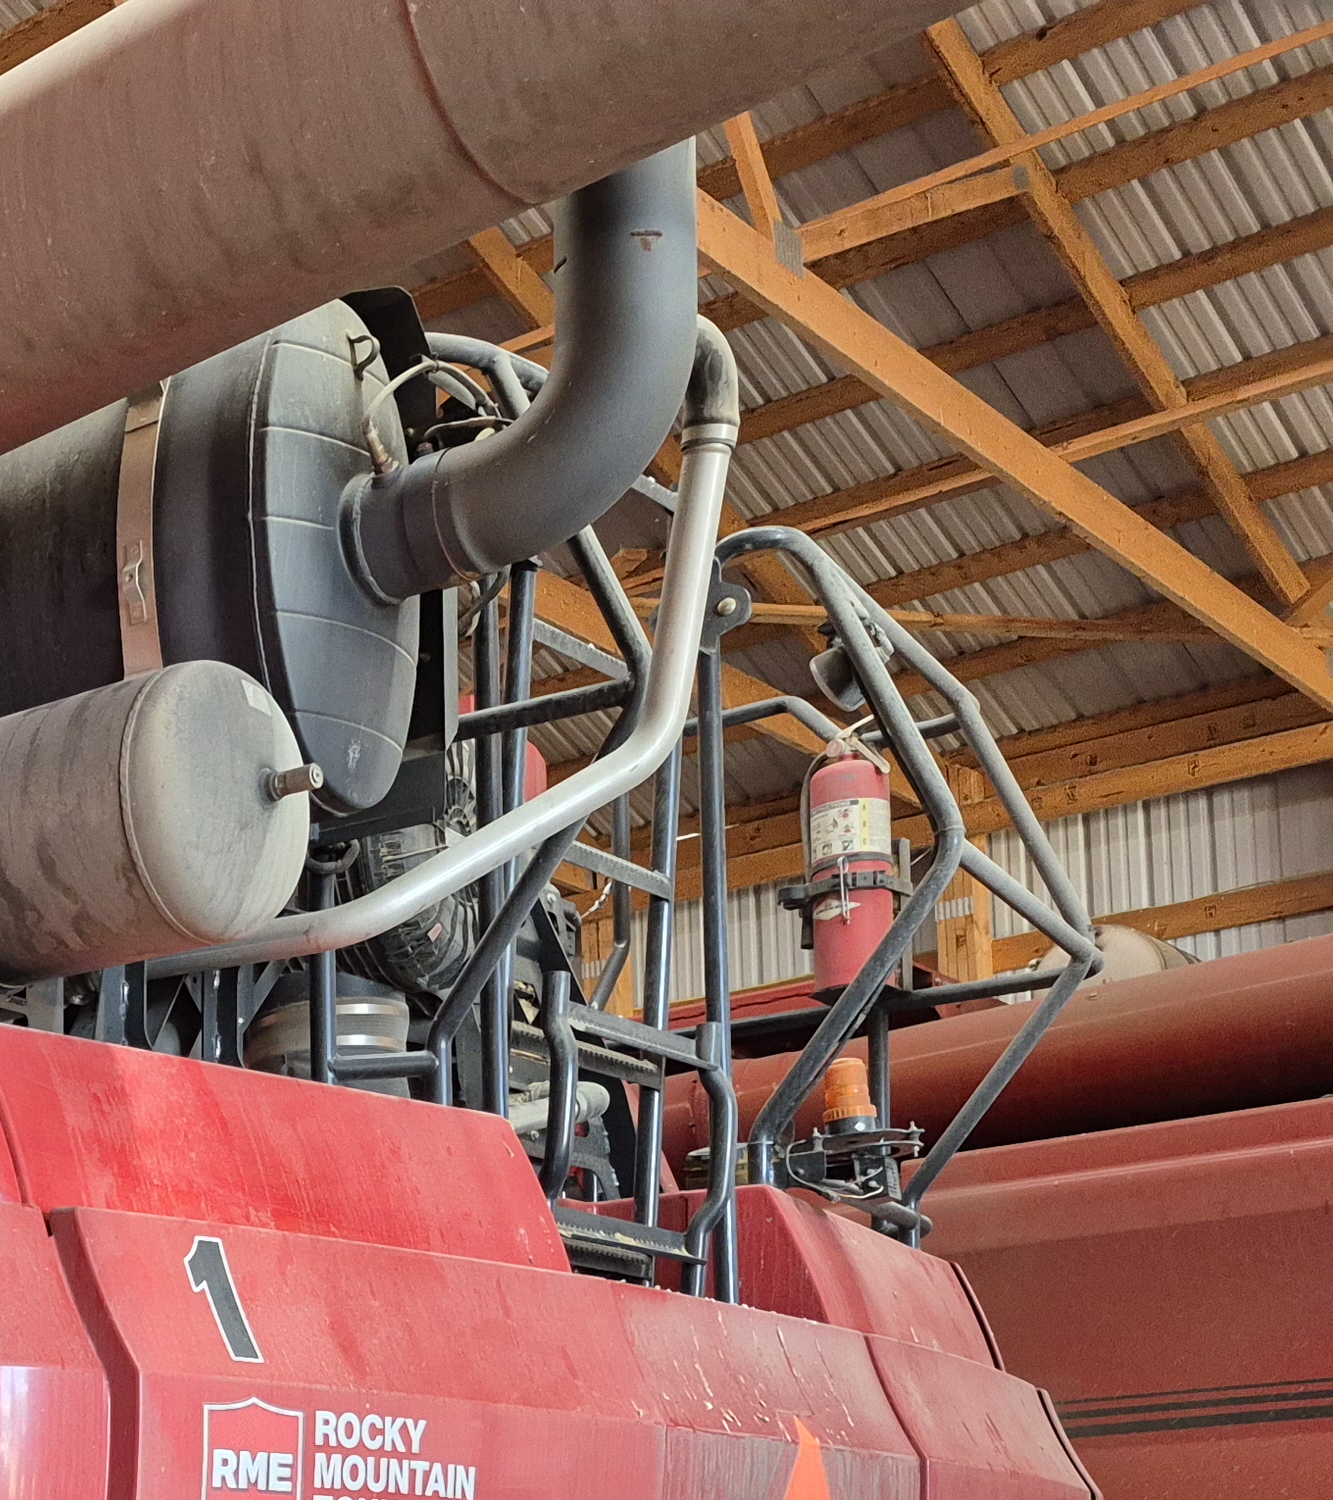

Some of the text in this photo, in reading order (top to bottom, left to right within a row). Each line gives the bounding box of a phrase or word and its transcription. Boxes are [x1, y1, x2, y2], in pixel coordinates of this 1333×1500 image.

[183, 1233, 265, 1364] 1
[314, 1410, 427, 1455] ROCKY
[211, 1448, 294, 1493] RME
[313, 1452, 476, 1500] MOUNTAIN
